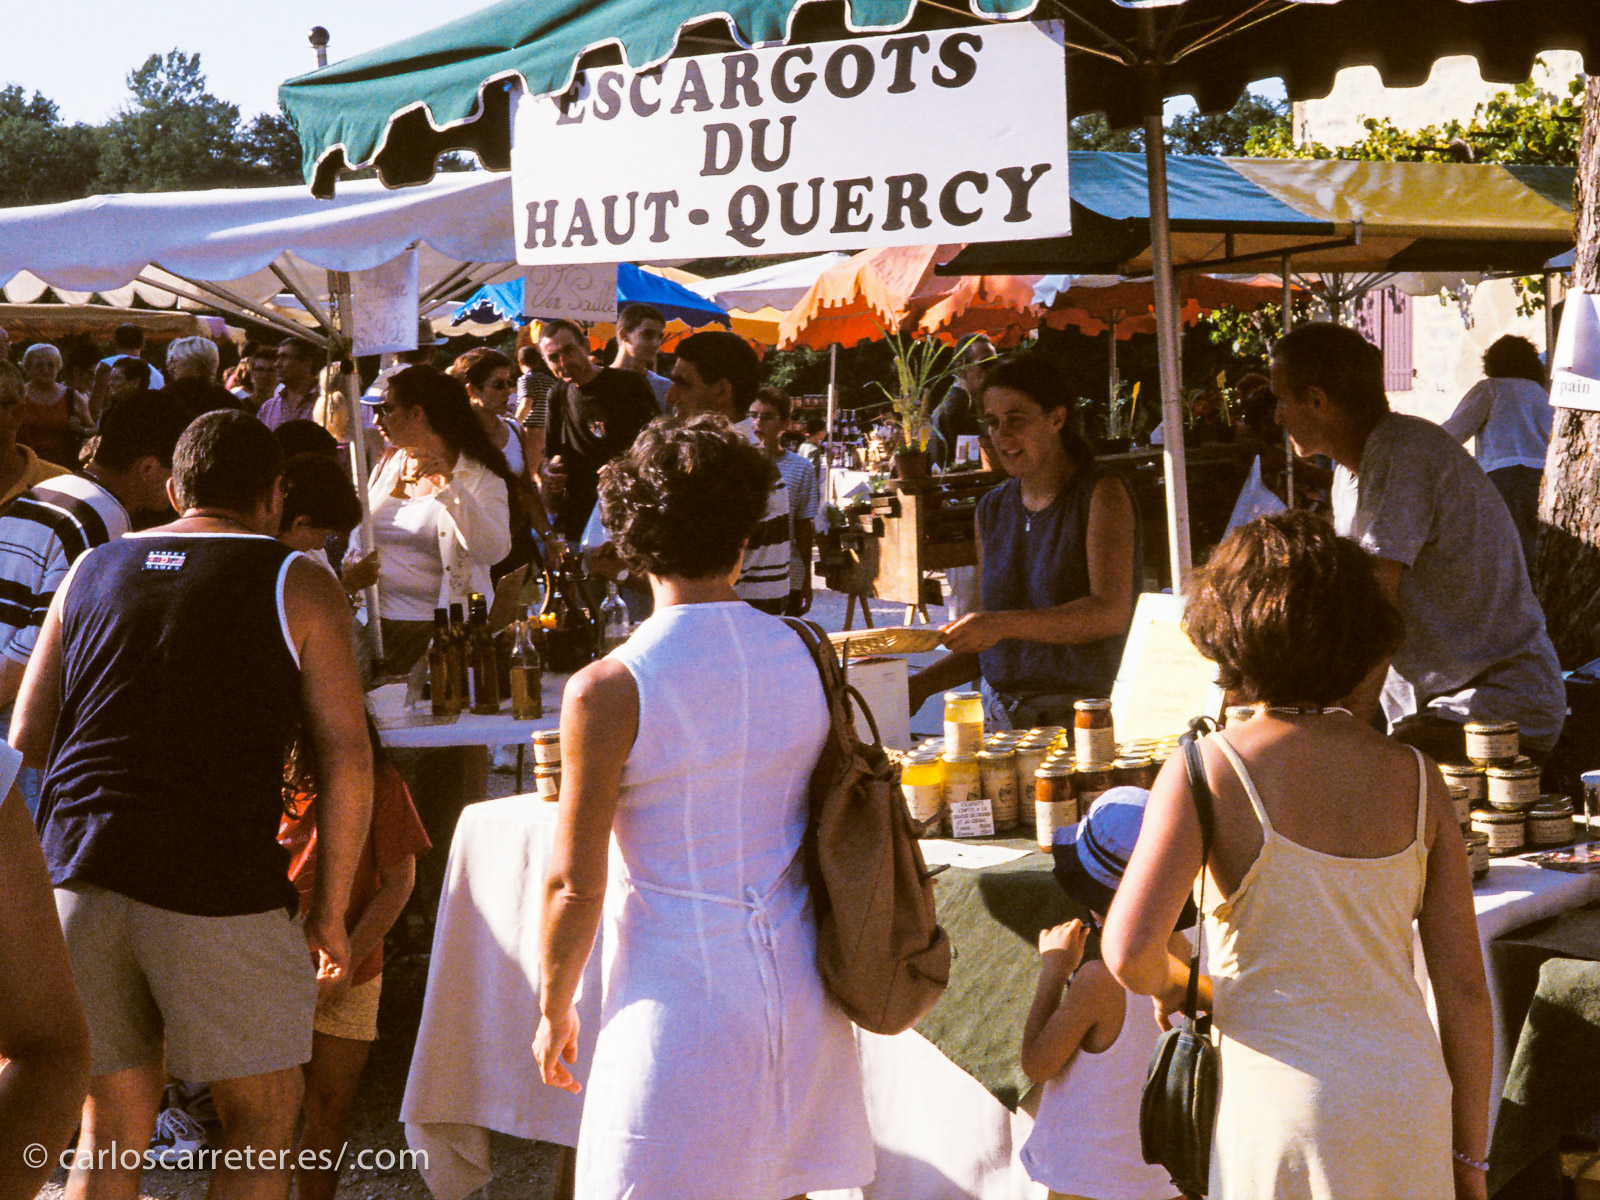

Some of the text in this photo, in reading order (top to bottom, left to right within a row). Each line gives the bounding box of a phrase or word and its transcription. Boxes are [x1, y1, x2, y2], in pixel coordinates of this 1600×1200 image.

[556, 33, 983, 126] ESCARGOTS
[700, 115, 797, 177] DU
[1560, 379, 1590, 396] pain
